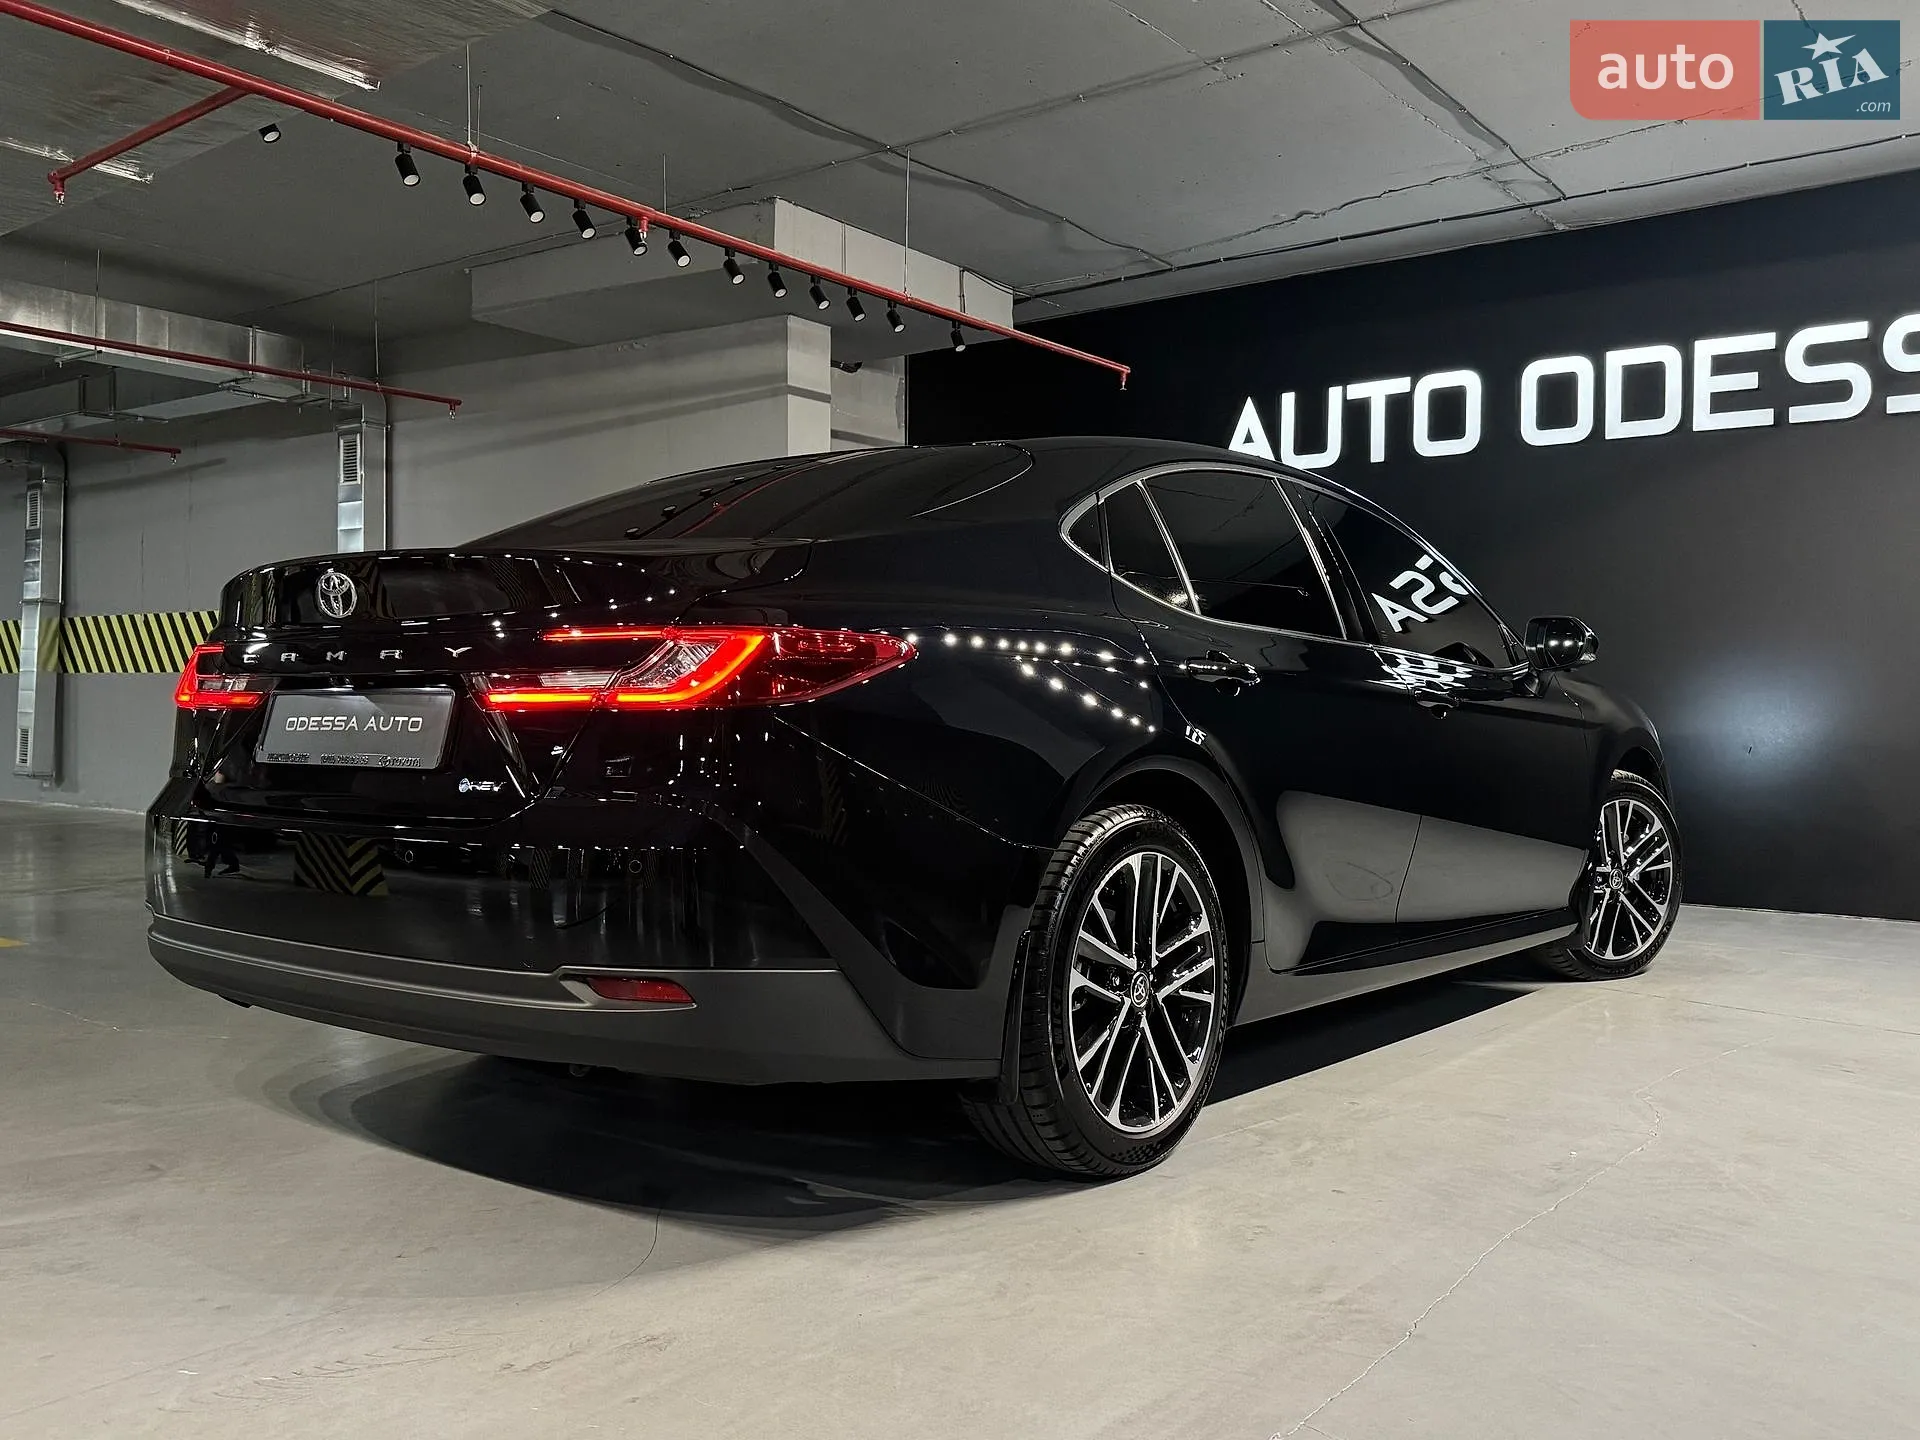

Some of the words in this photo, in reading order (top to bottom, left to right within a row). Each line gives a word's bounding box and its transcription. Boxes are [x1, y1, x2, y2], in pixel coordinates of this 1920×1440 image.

[1228, 369, 1482, 470] AUTO
[243, 646, 473, 664] CAMRY
[285, 716, 359, 732] ODESSA
[364, 716, 423, 732] AUTO
